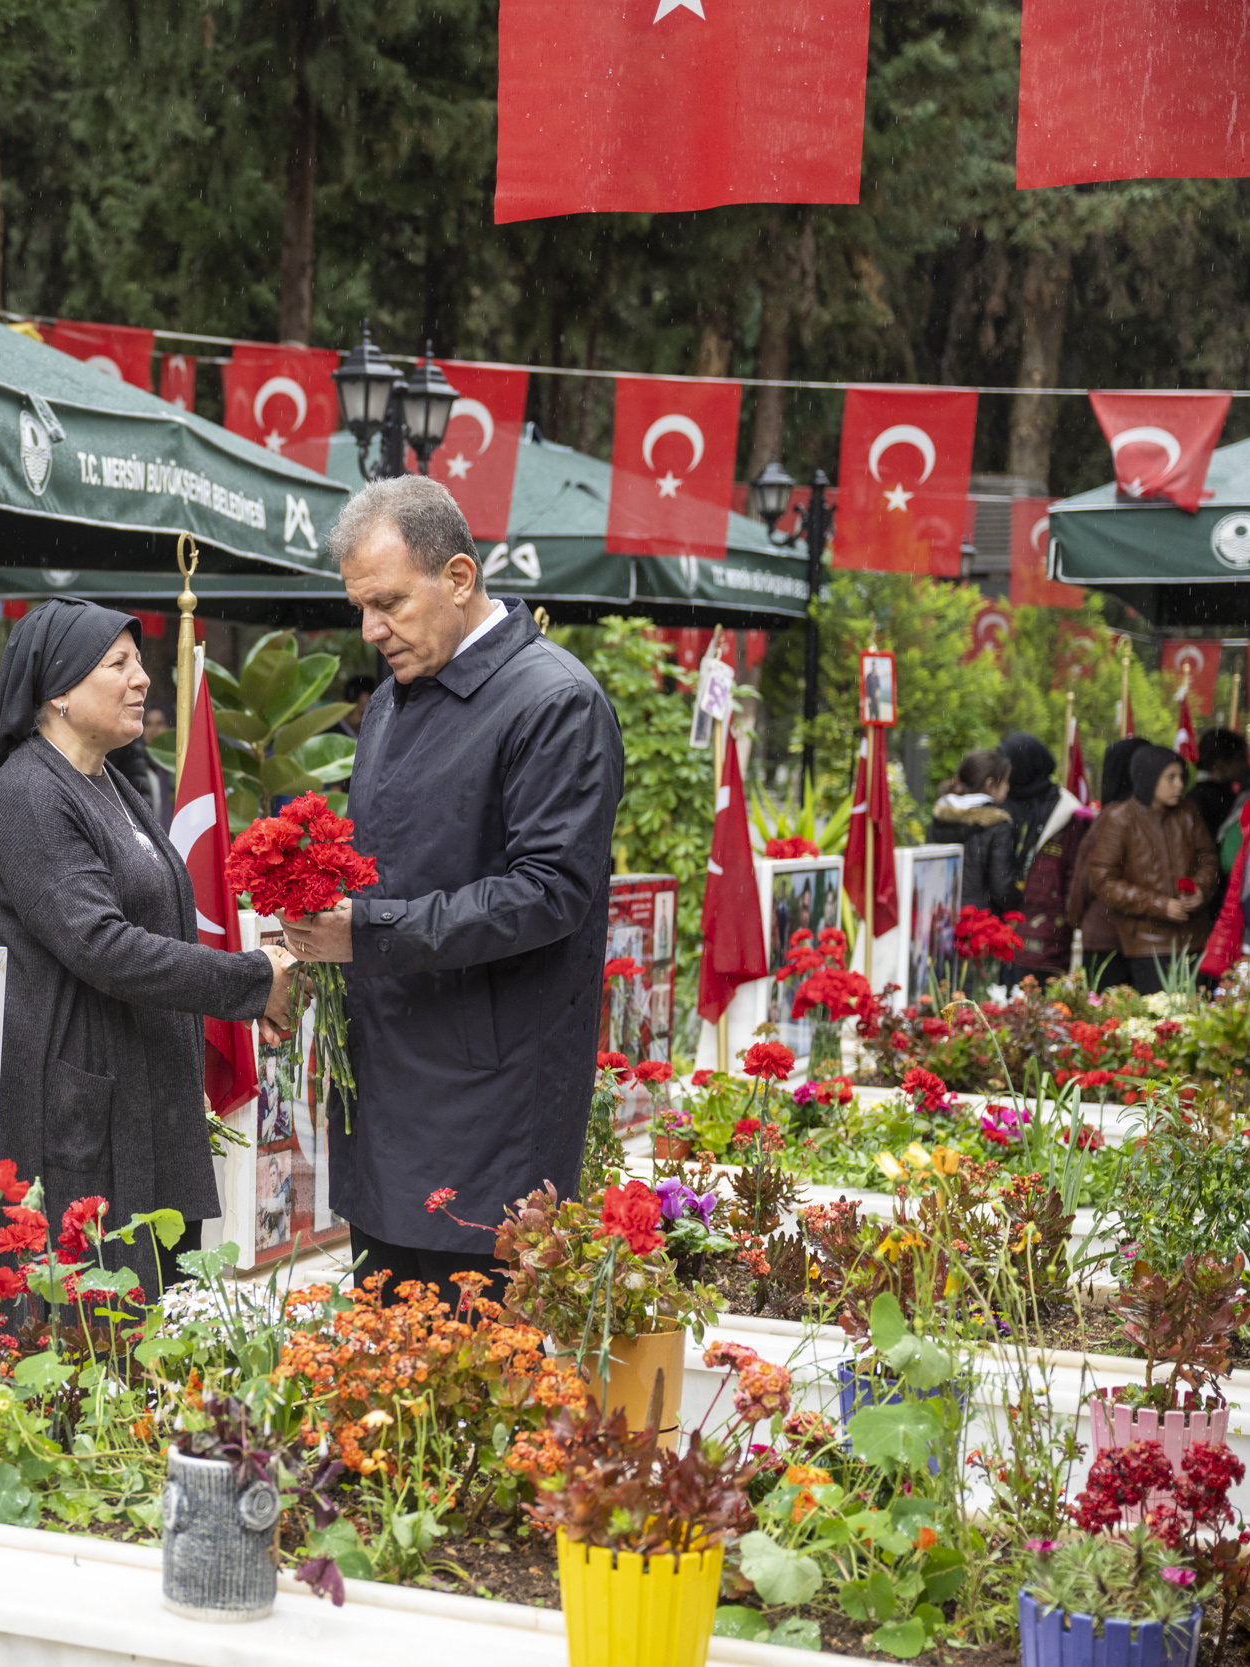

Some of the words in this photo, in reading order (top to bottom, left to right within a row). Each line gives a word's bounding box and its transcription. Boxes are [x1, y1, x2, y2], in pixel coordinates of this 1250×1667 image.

[77, 451, 101, 486] T.C.
[101, 453, 145, 491] MERSİN
[147, 457, 212, 508] BÜYÜKŞEHİR
[212, 483, 266, 530] BELEDİYESİ
